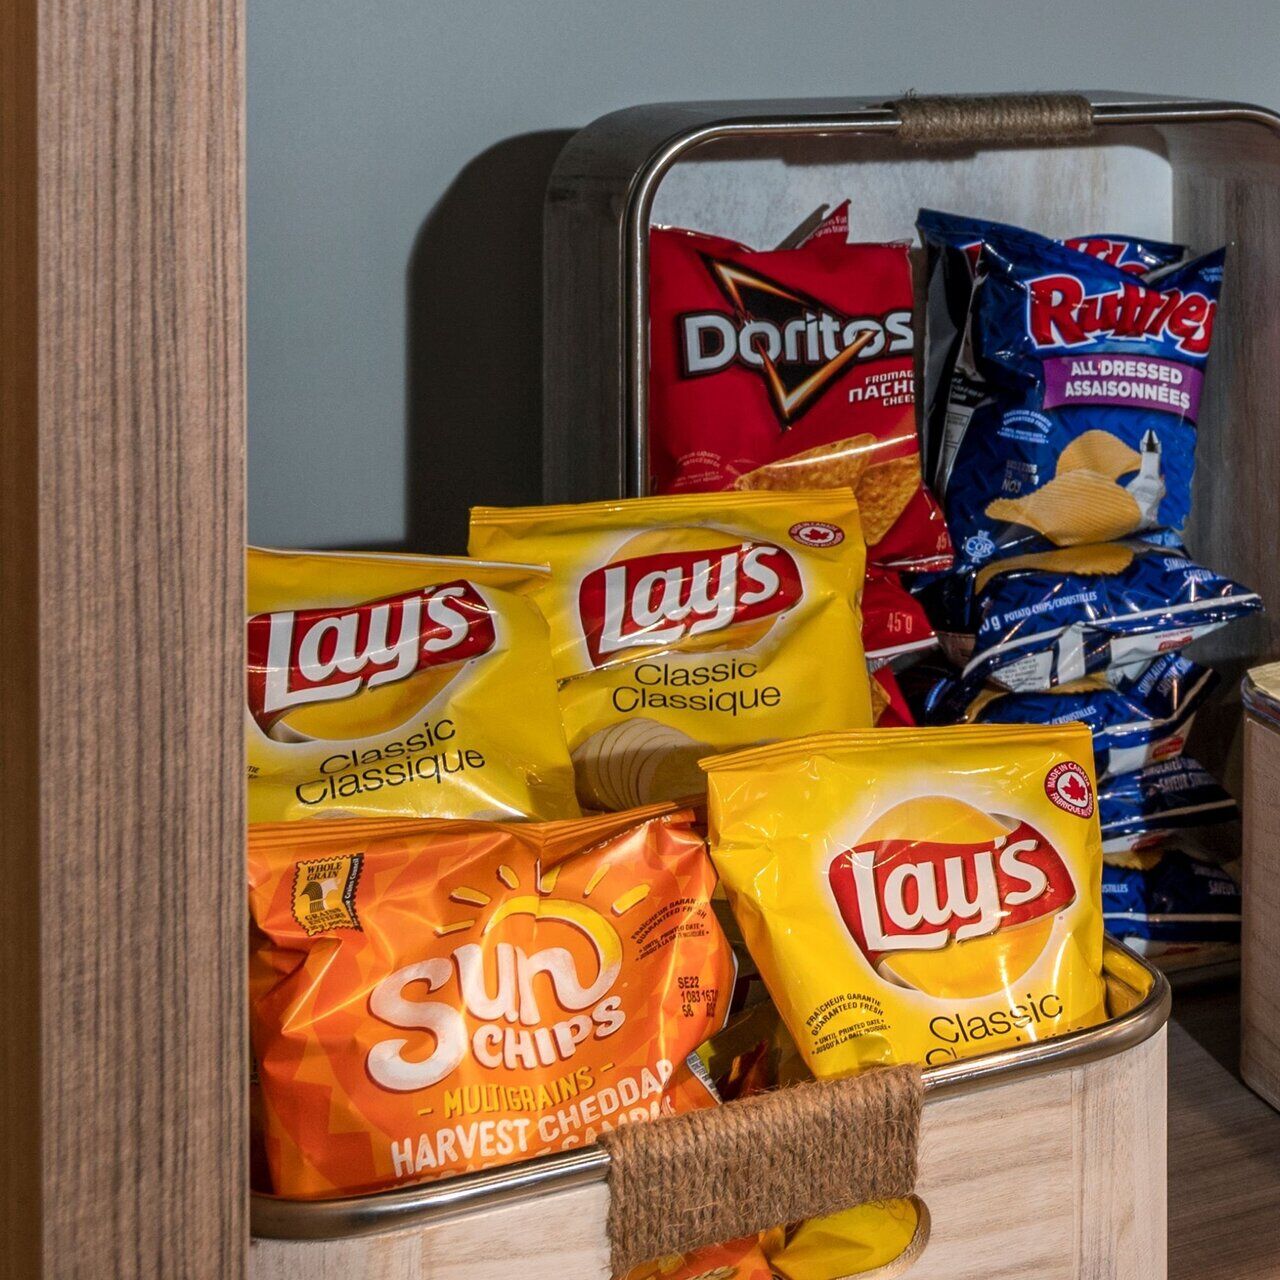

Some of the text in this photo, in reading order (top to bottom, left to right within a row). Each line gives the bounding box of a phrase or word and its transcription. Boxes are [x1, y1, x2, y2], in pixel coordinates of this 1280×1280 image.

[684, 312, 914, 373] Doritos
[1071, 360, 1182, 384] ALL DRESSED
[1065, 381, 1190, 410] ASSAISONNÉES
[598, 542, 780, 654] Lay's
[1003, 606, 1031, 624] POTATO
[887, 611, 913, 634] 45 g
[264, 586, 469, 713] Lay's
[634, 658, 758, 687] Classic
[612, 685, 782, 717] Classique
[319, 718, 456, 776] Classic
[295, 748, 486, 805] Classique
[306, 861, 343, 874] WHOLE
[306, 870, 339, 881] GRAIN
[851, 835, 1048, 952] Lay's
[682, 906, 708, 919] FRSH
[678, 977, 699, 989] SE22
[847, 992, 882, 1007] GARANTIE
[472, 995, 626, 1070] CHIPS
[811, 1001, 885, 1037] GUARANTEED FRESH
[928, 992, 1064, 1044] Classic
[443, 1066, 594, 1119] MULTIGRAINS
[391, 1118, 530, 1178] HARVEST
